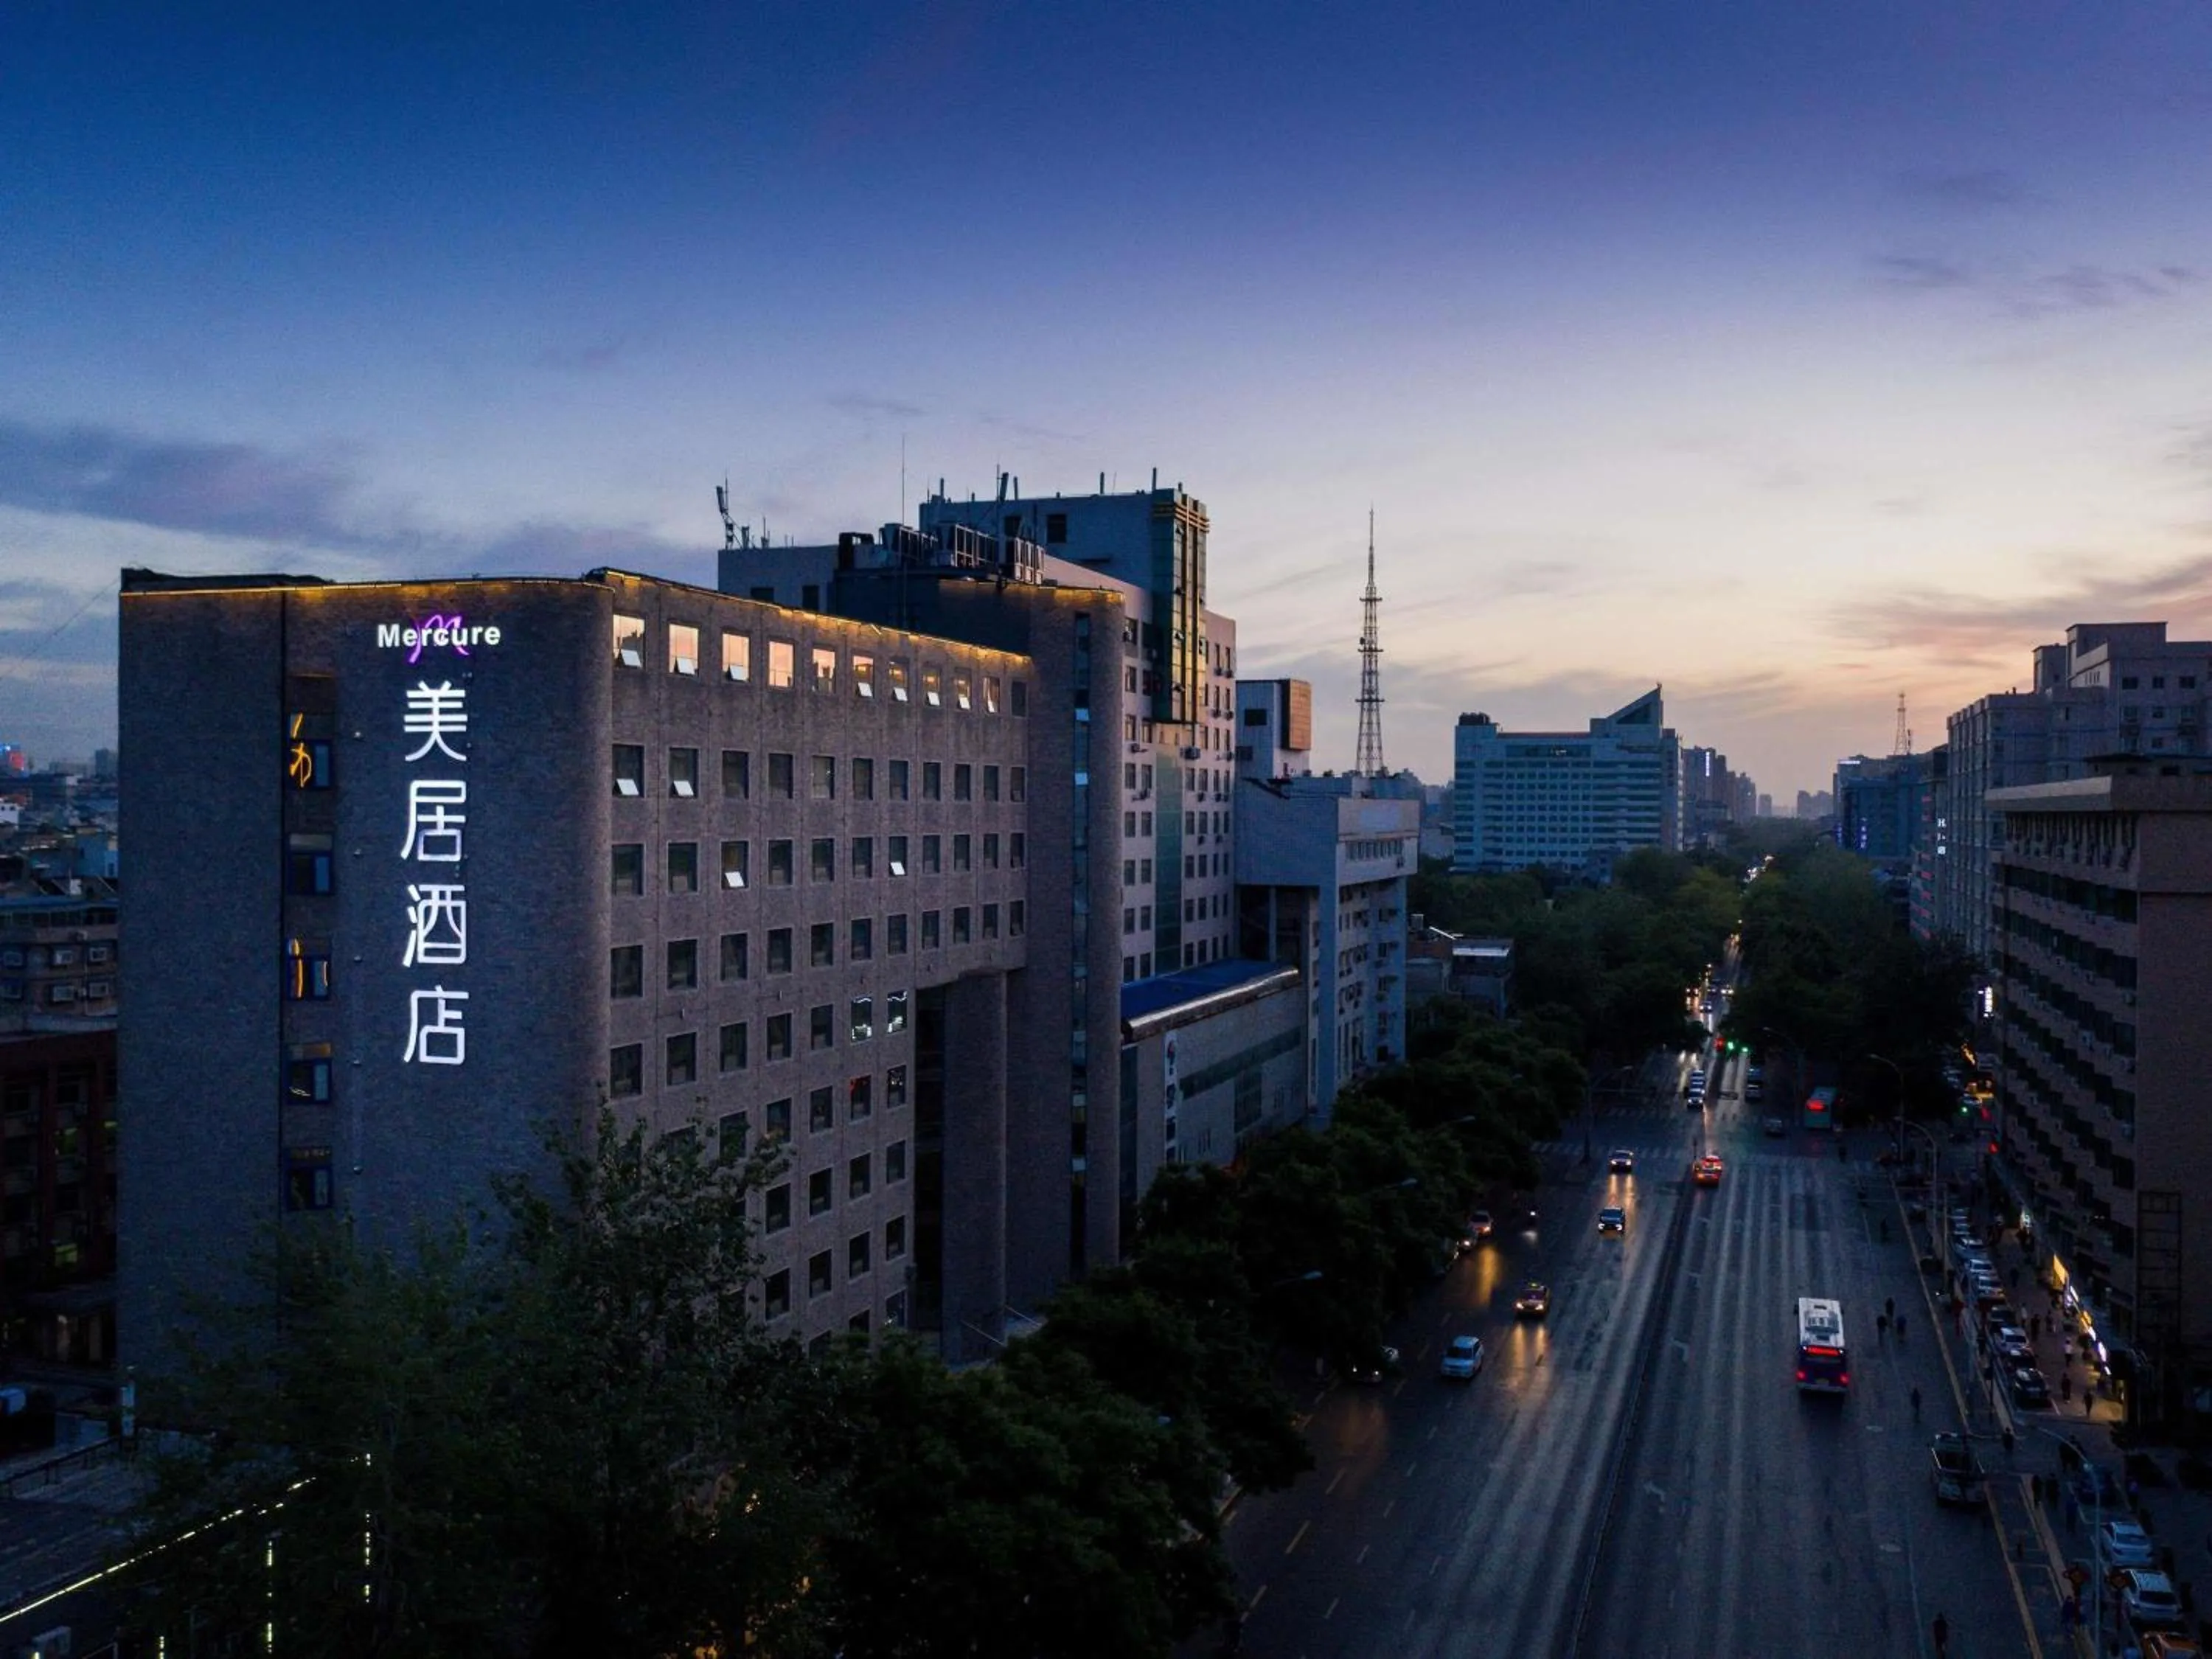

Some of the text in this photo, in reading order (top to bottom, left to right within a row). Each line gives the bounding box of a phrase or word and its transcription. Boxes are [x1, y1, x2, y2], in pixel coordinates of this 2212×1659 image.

[378, 624, 501, 648] Mercure
[400, 680, 470, 1065] 美居酒店
